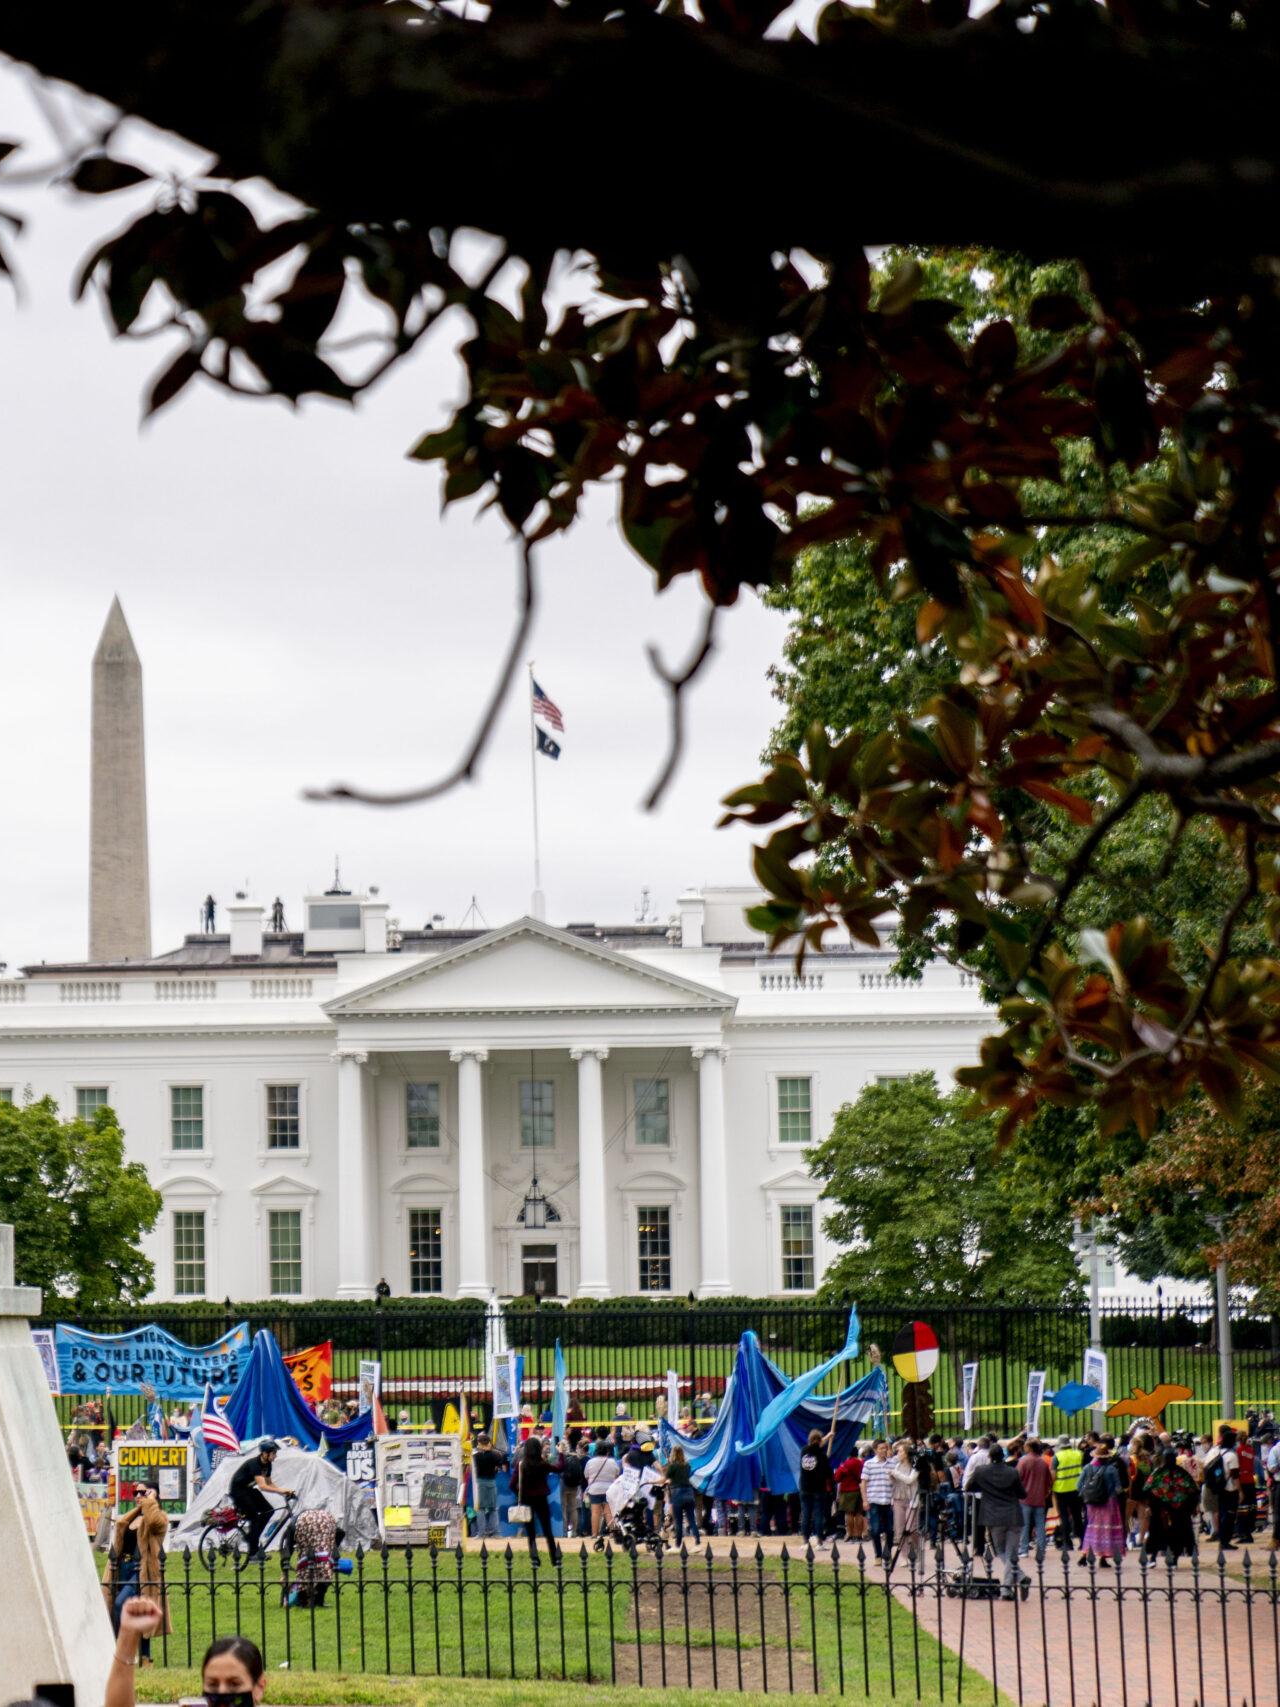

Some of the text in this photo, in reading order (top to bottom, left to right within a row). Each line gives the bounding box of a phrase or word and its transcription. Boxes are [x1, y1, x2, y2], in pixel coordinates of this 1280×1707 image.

[72, 1348, 98, 1360] FOR
[104, 1349, 130, 1361] THE
[181, 1350, 237, 1366] WATERS
[72, 1362, 239, 1386] & OUR FUTURE
[346, 1450, 374, 1460] ABOUT
[352, 1442, 369, 1451] IT'S
[119, 1447, 188, 1466] CONVERT
[119, 1467, 149, 1481] THE
[346, 1459, 375, 1481] US
